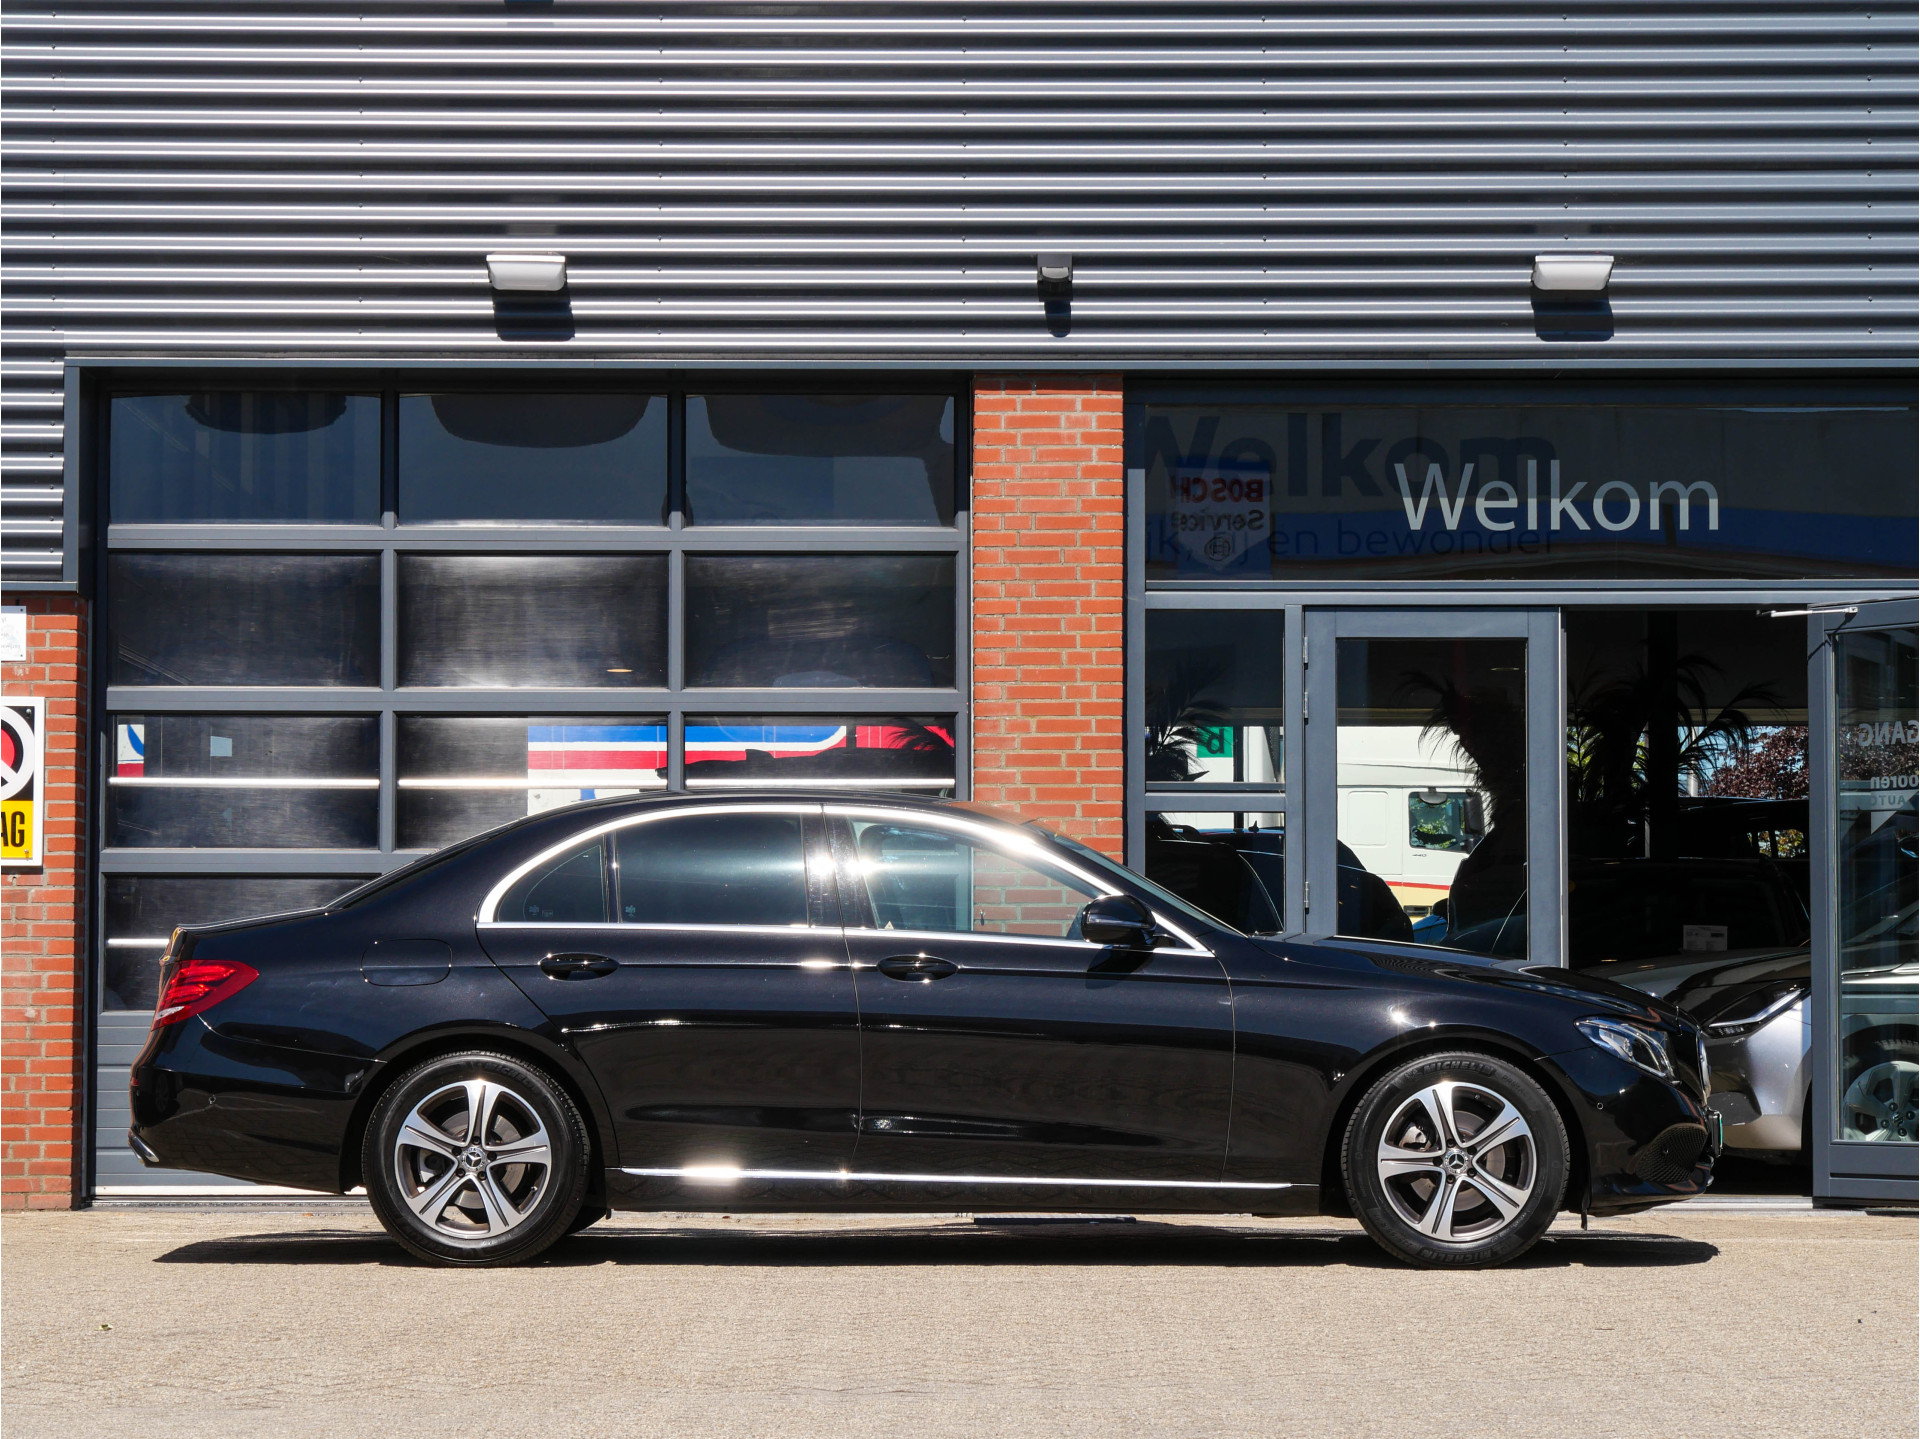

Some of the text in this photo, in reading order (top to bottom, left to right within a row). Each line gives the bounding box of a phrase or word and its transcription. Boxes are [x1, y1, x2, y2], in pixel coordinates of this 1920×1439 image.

[1395, 459, 1720, 531] Welkom
[1267, 529, 1318, 556] en
[1422, 1060, 1496, 1077] MICHELIN
